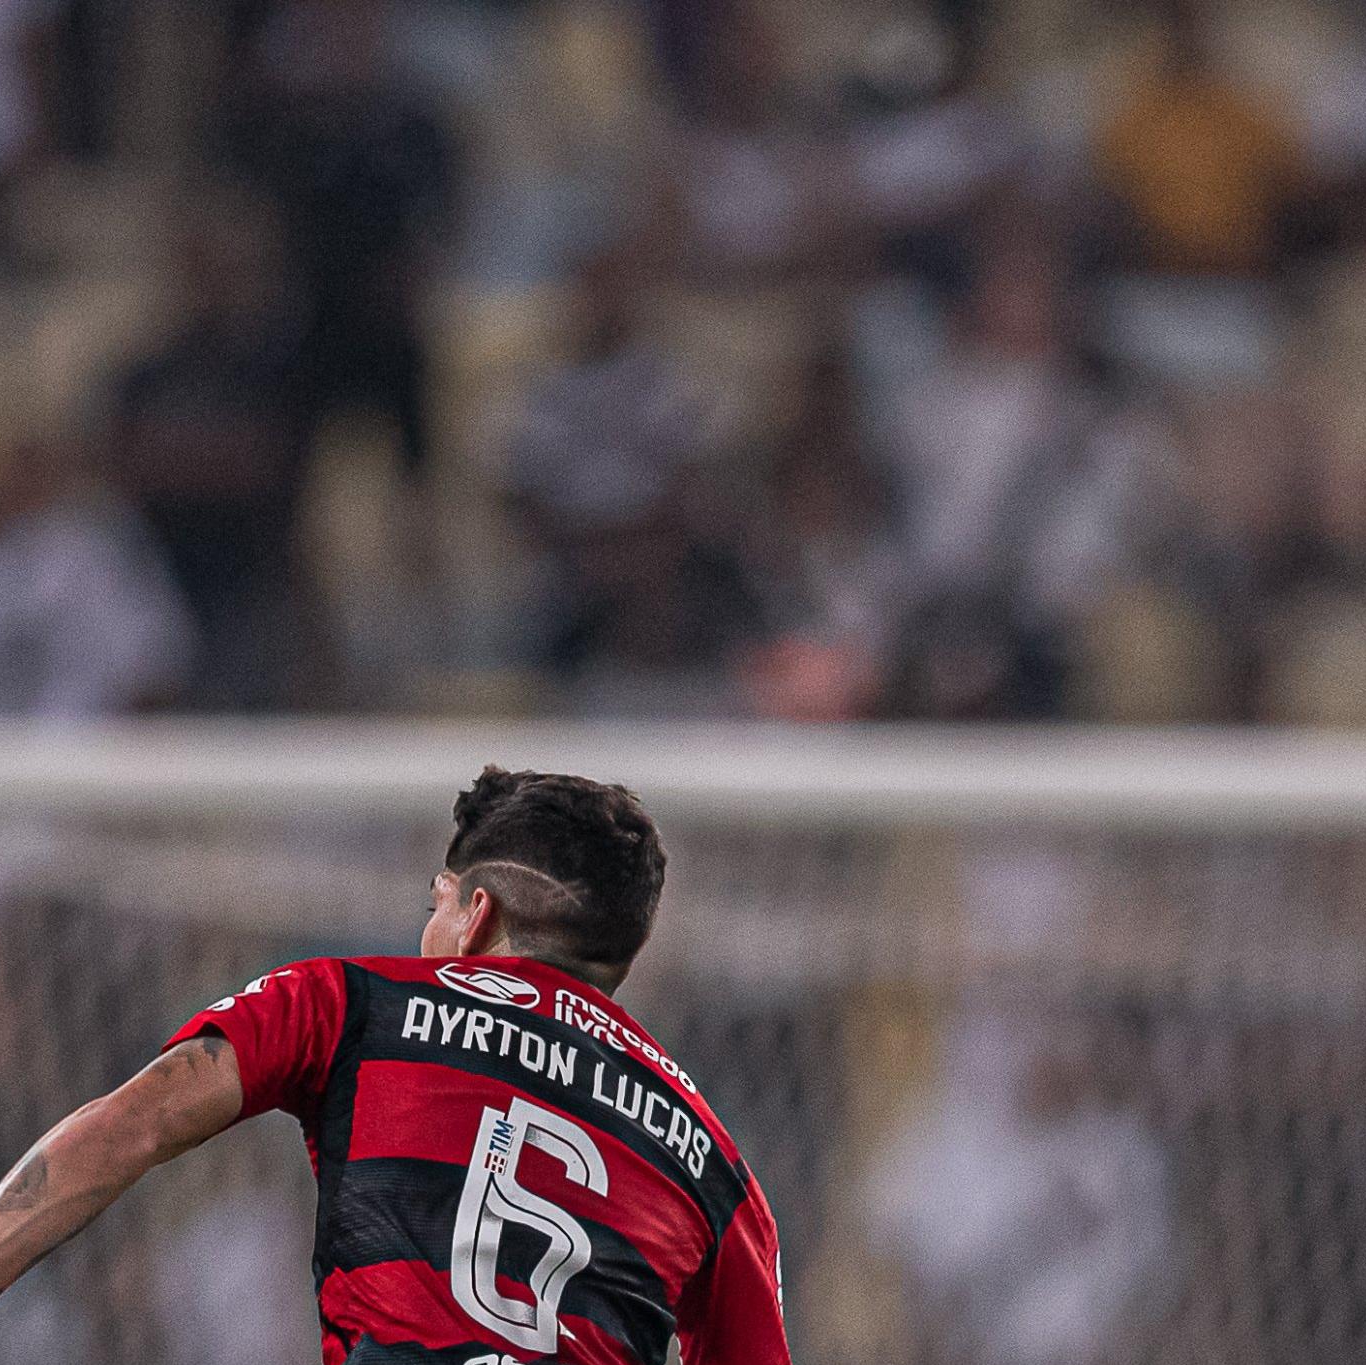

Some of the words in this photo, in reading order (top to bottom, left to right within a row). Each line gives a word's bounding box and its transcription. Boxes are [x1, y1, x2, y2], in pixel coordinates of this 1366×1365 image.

[555, 1002, 628, 1052] livre
[555, 988, 698, 1095] mercado
[401, 996, 578, 1087] AYRTON
[591, 1061, 712, 1180] LUCAS
[488, 1118, 516, 1156] TIM
[450, 1095, 610, 1355] 6
